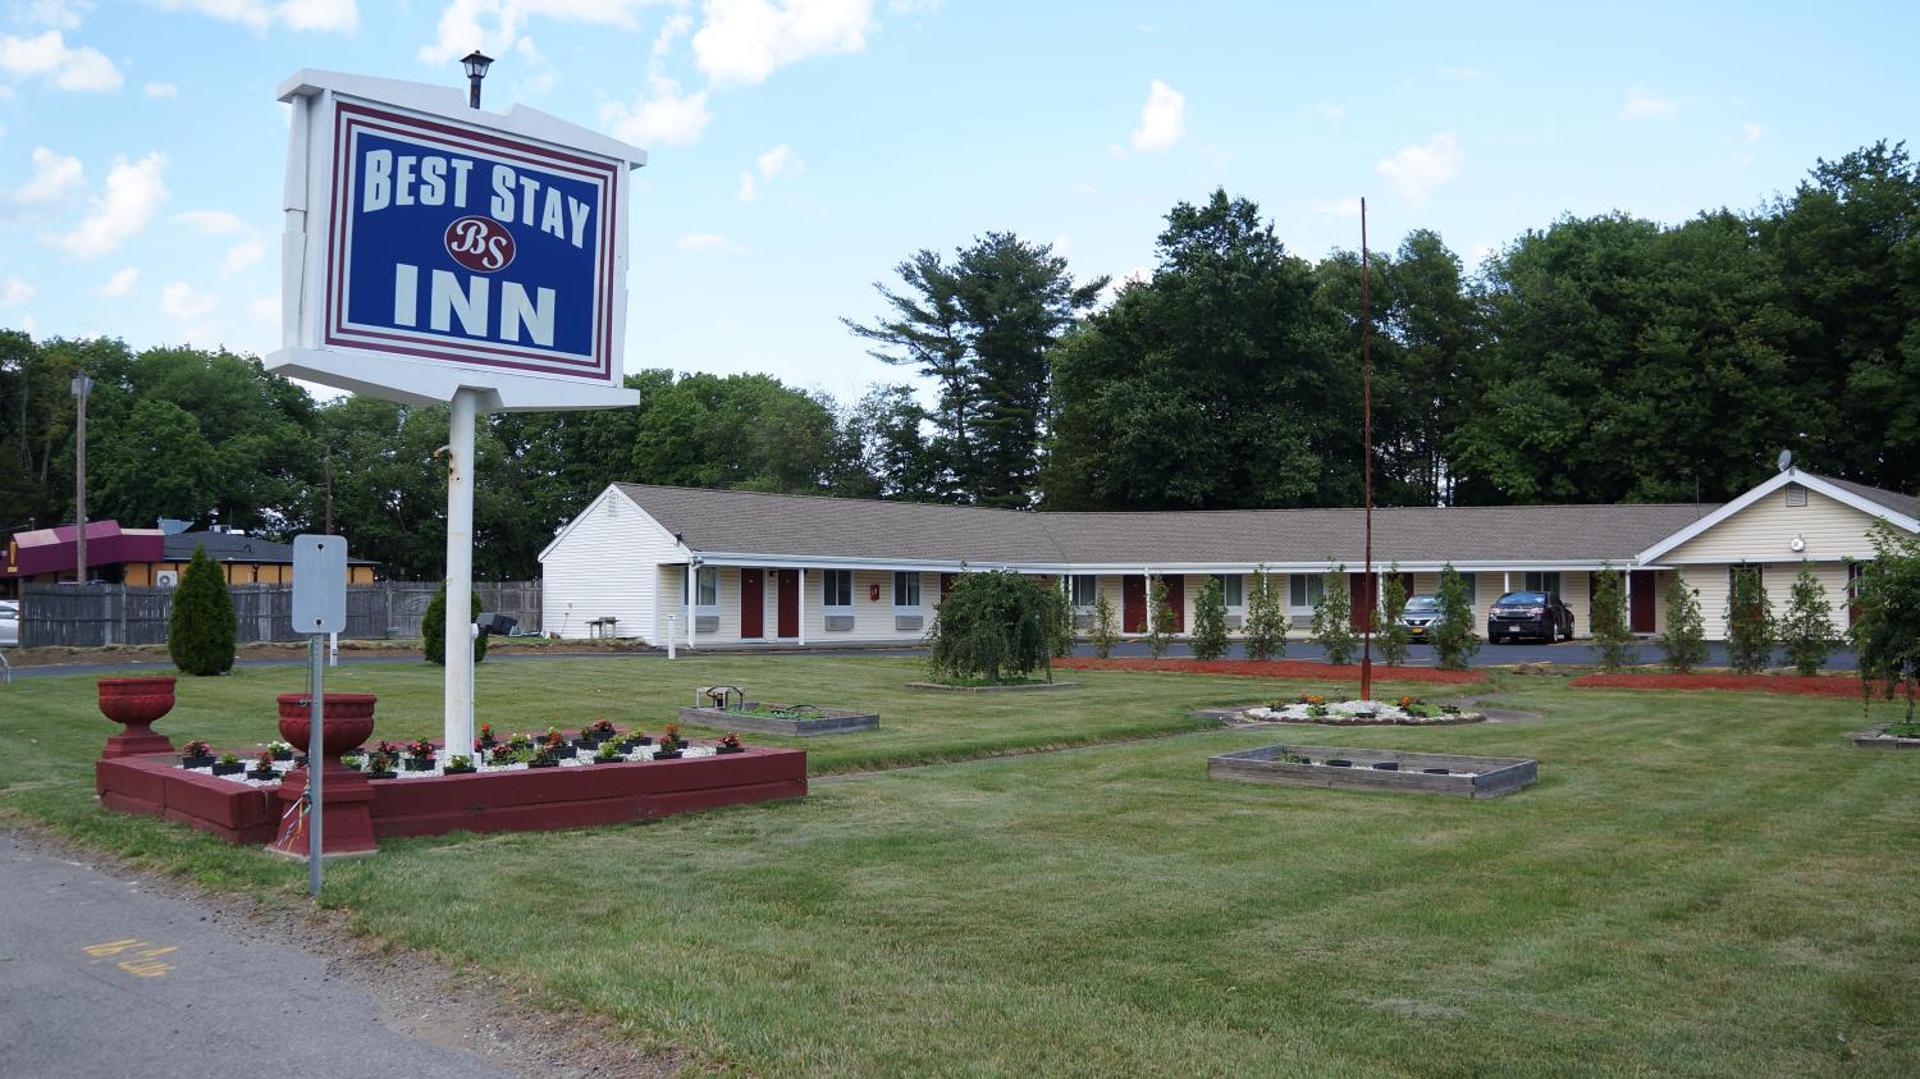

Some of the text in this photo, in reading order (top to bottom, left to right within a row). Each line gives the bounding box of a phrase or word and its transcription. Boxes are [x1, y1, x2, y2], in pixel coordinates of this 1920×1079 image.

[363, 149, 590, 249] BEST STAY
[451, 219, 508, 270] BS
[394, 263, 556, 347] INN
